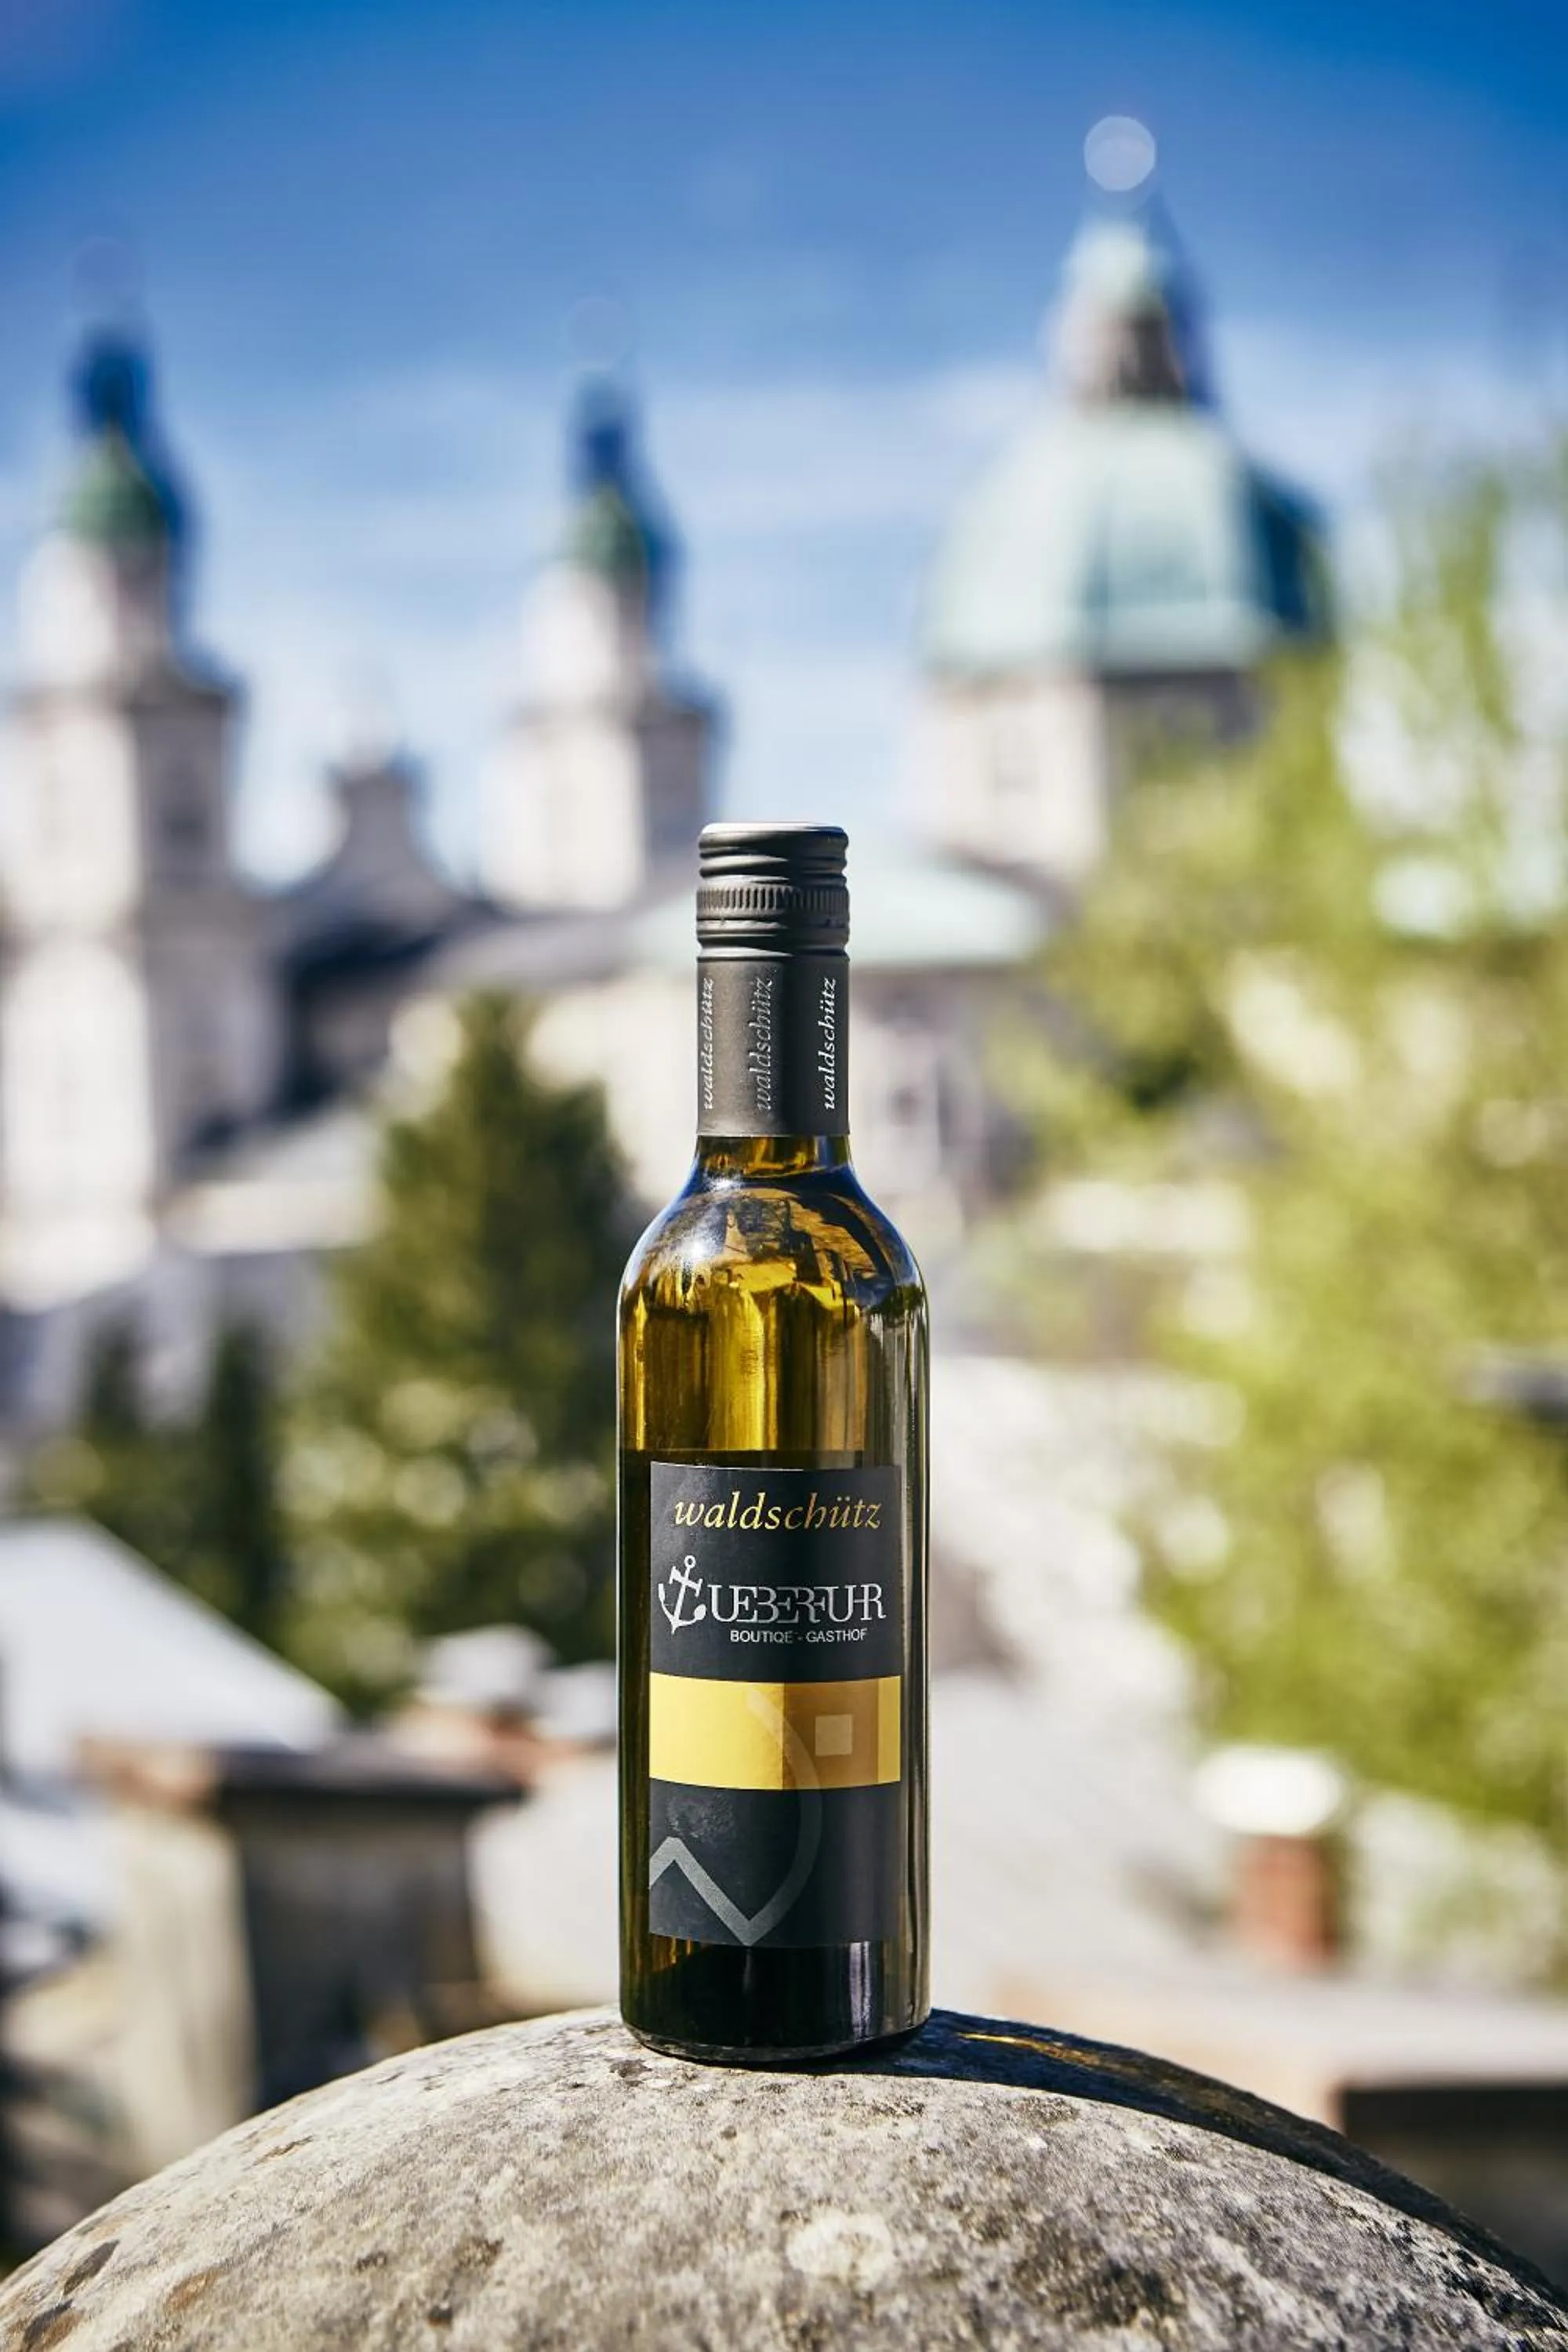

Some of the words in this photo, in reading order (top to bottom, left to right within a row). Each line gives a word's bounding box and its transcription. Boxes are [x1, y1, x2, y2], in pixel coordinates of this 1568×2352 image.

[749, 977, 772, 1111] waldschütz
[818, 977, 837, 1110] waldschütz
[674, 1490, 882, 1530] waldschütz
[806, 1628, 868, 1642] GASTHOF
